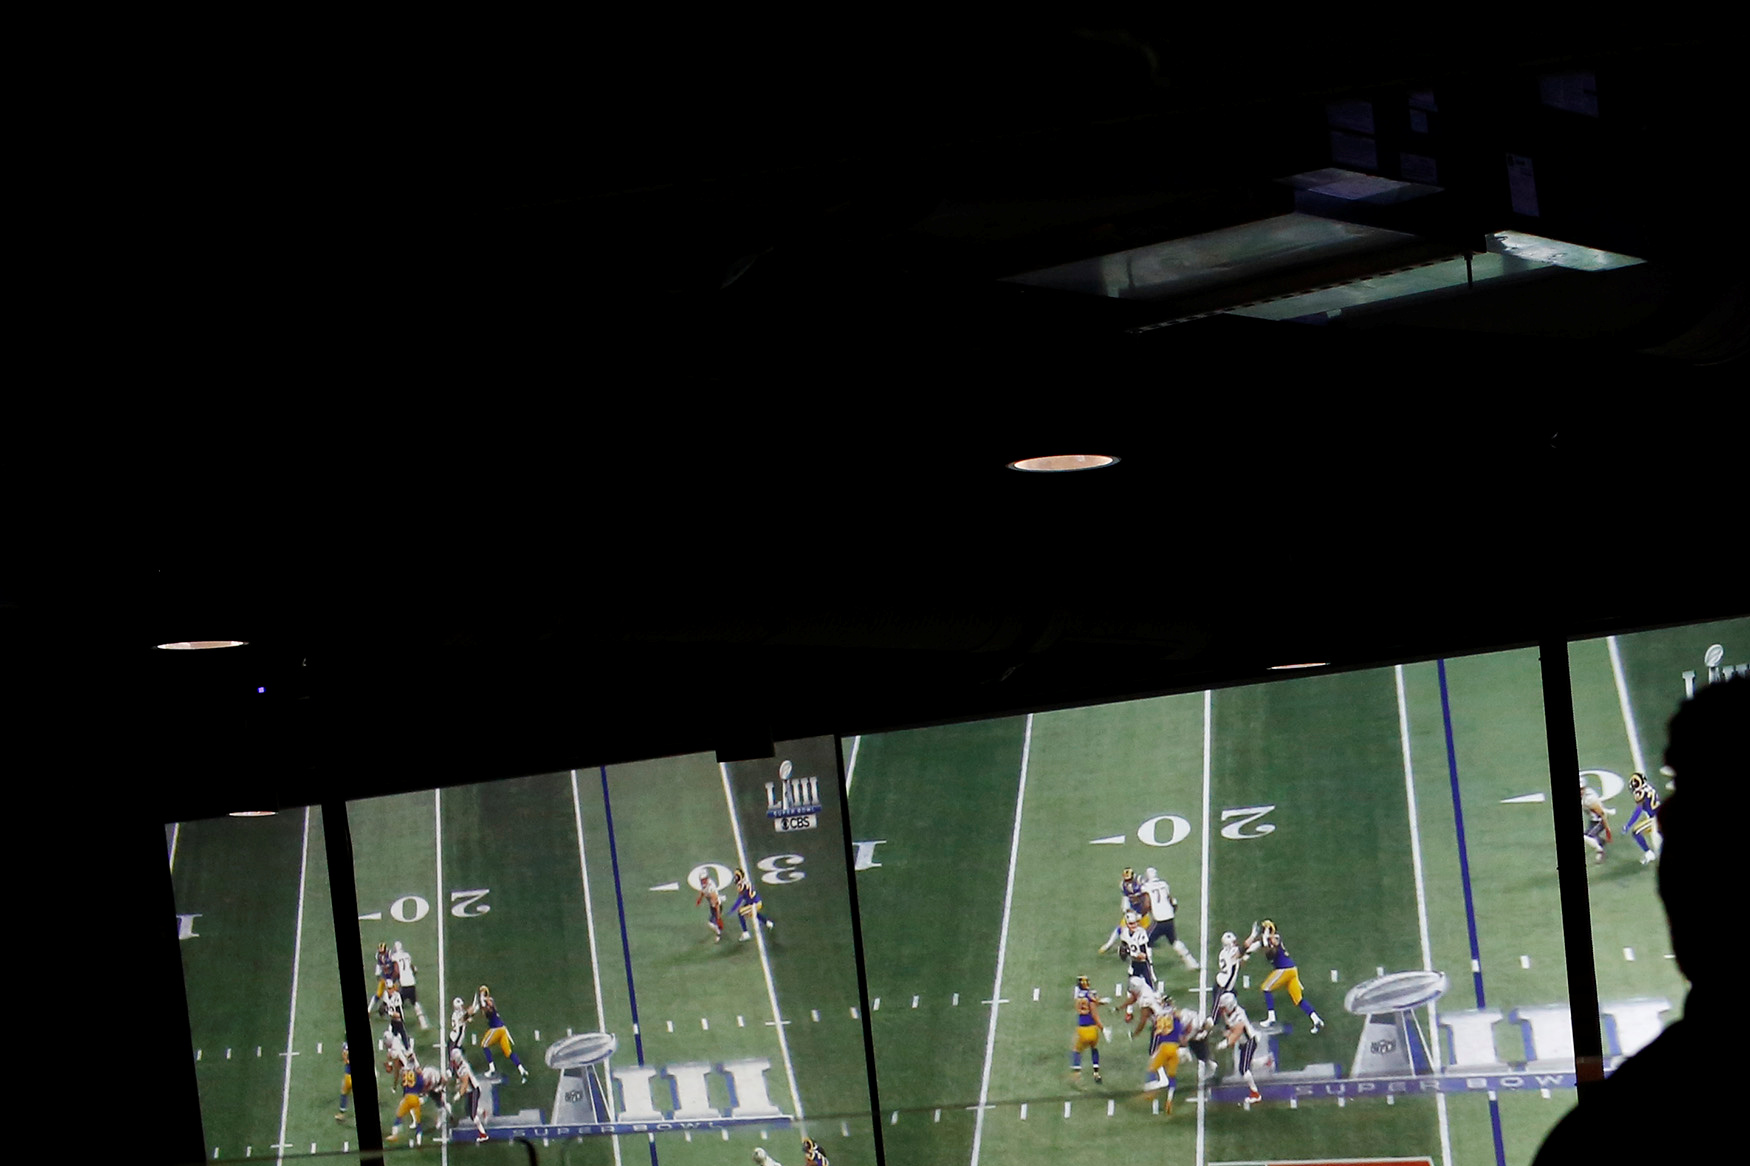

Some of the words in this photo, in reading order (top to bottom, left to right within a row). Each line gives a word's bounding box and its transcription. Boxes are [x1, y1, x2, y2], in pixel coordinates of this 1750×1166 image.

[790, 816, 810, 829] CBS
[1296, 1078, 1440, 1097] SUPER
[1467, 1073, 1565, 1090] BOW
